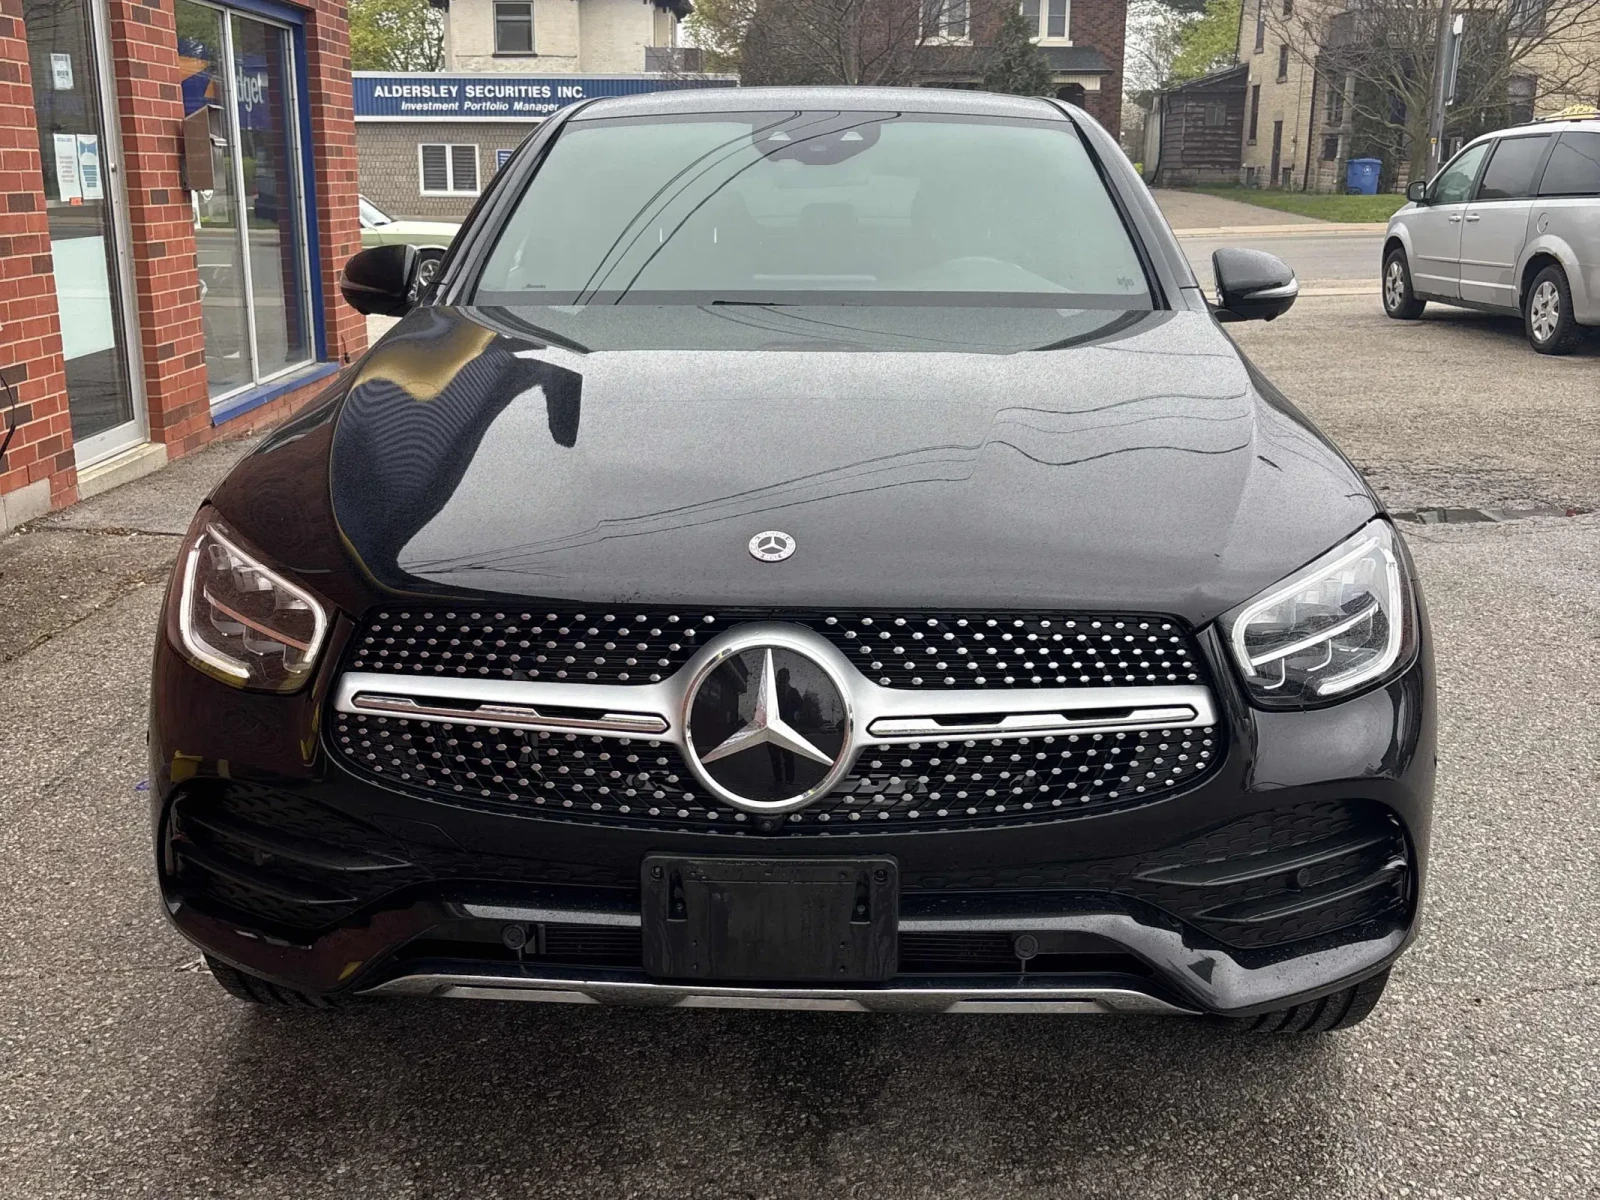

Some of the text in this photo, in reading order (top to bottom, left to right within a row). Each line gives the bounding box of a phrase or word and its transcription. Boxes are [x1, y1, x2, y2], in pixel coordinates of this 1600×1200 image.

[374, 85, 587, 98] ALDERSLEY SECURITIES INC.
[401, 101, 559, 113] Investment Portfolio Manager
